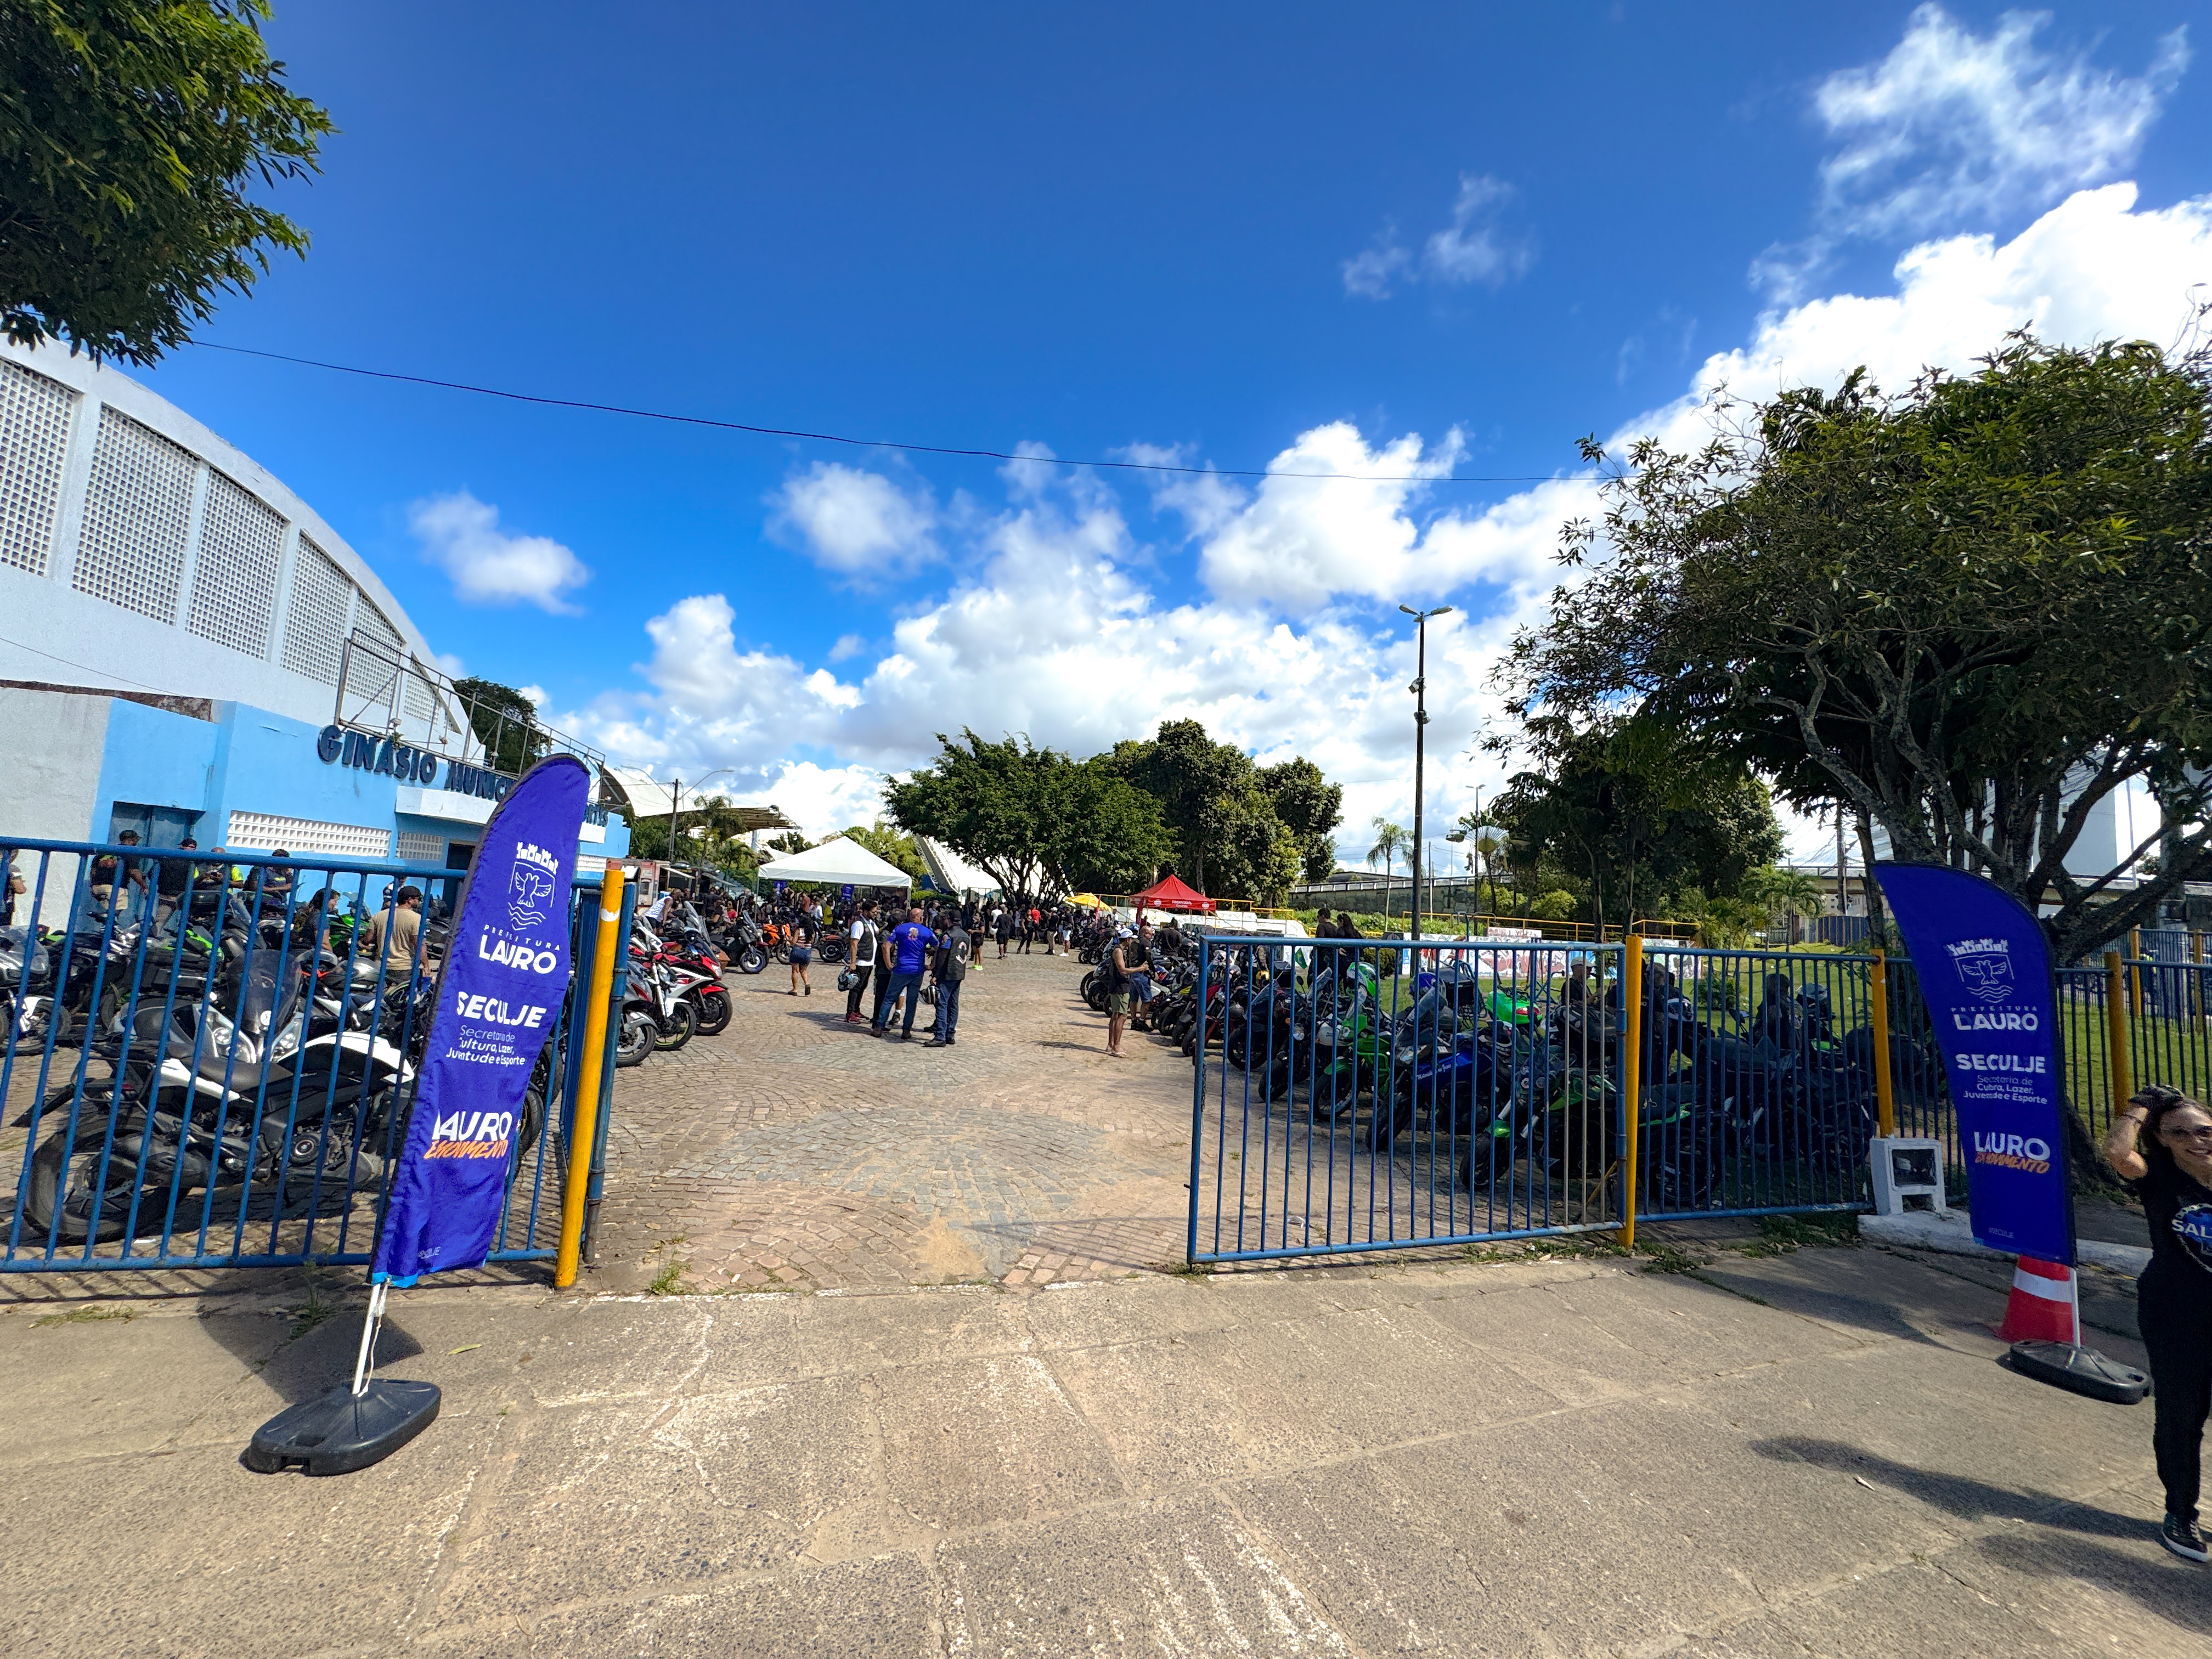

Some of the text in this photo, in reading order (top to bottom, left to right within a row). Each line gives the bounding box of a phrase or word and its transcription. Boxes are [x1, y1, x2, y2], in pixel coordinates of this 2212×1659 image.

[484, 924, 560, 951] PREFEITURA
[479, 934, 557, 974] LAURO
[456, 991, 547, 1029] SECULJE
[1953, 1013, 2039, 1031] LAURO
[500, 1054, 526, 1068] Esporte
[1955, 1053, 2046, 1074] SECULJE
[2006, 1084, 2034, 1095] Lazer,
[2012, 1093, 2049, 1105] Esporte
[432, 1109, 512, 1142] LAURO
[1974, 1131, 2050, 1161] LAURO
[2171, 1218, 2212, 1239] SAL
